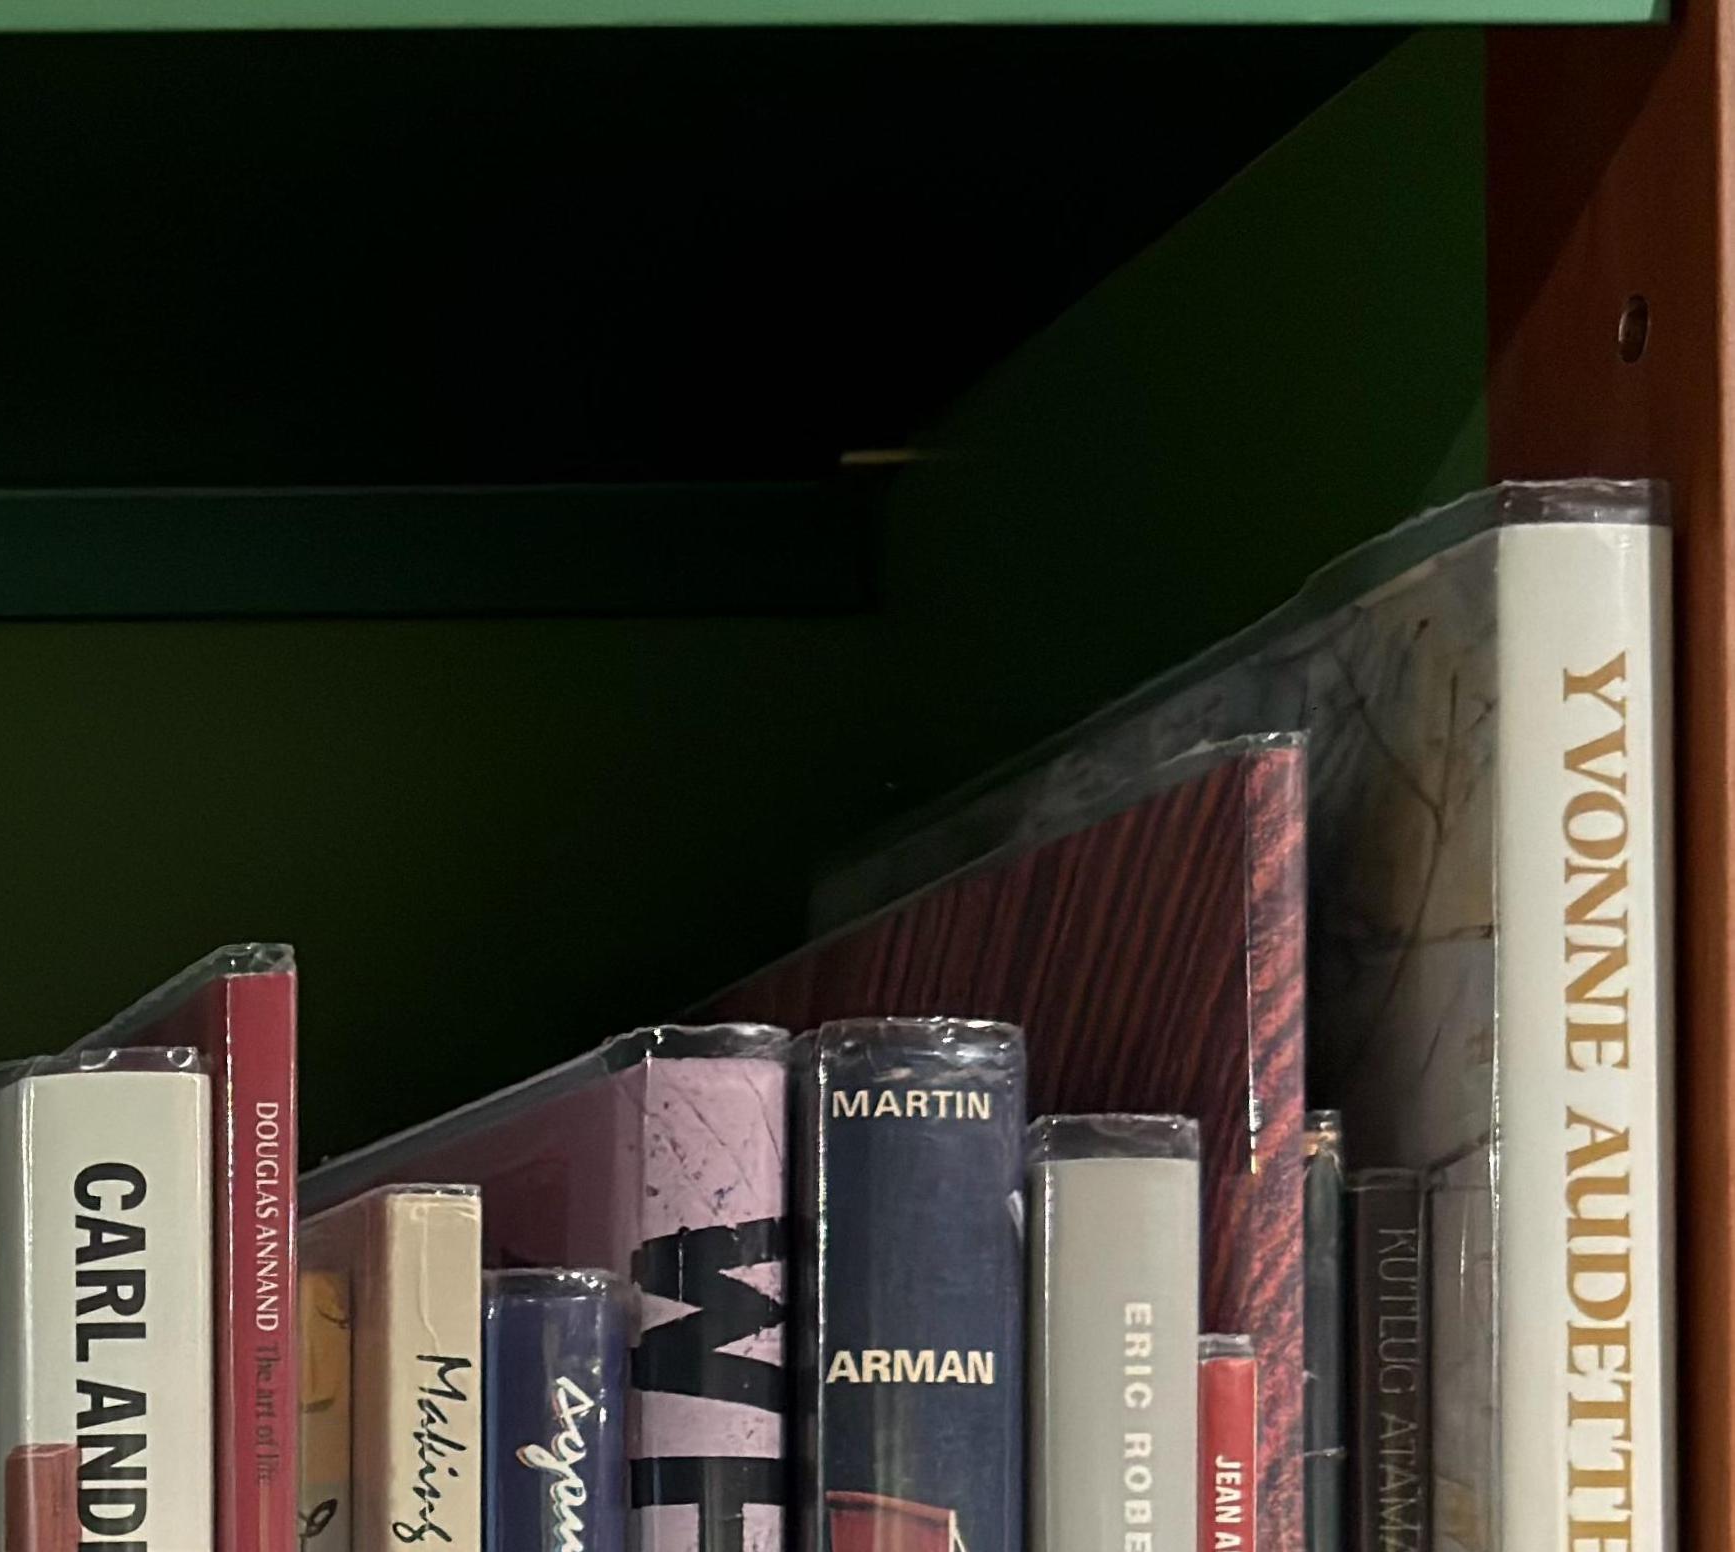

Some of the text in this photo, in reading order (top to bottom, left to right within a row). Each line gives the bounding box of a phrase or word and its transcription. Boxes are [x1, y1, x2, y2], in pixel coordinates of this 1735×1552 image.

[1562, 651, 1631, 1074] YVONNE
[830, 1088, 992, 1122] MARTIN
[73, 1162, 148, 1363] CARL
[255, 1102, 279, 1332] DOUGLAS ANNAND
[824, 1345, 996, 1386] ARMAN
[1124, 1303, 1153, 1409] ERIC
[392, 1354, 472, 1544] Making
[1214, 1455, 1242, 1526] JEAN
